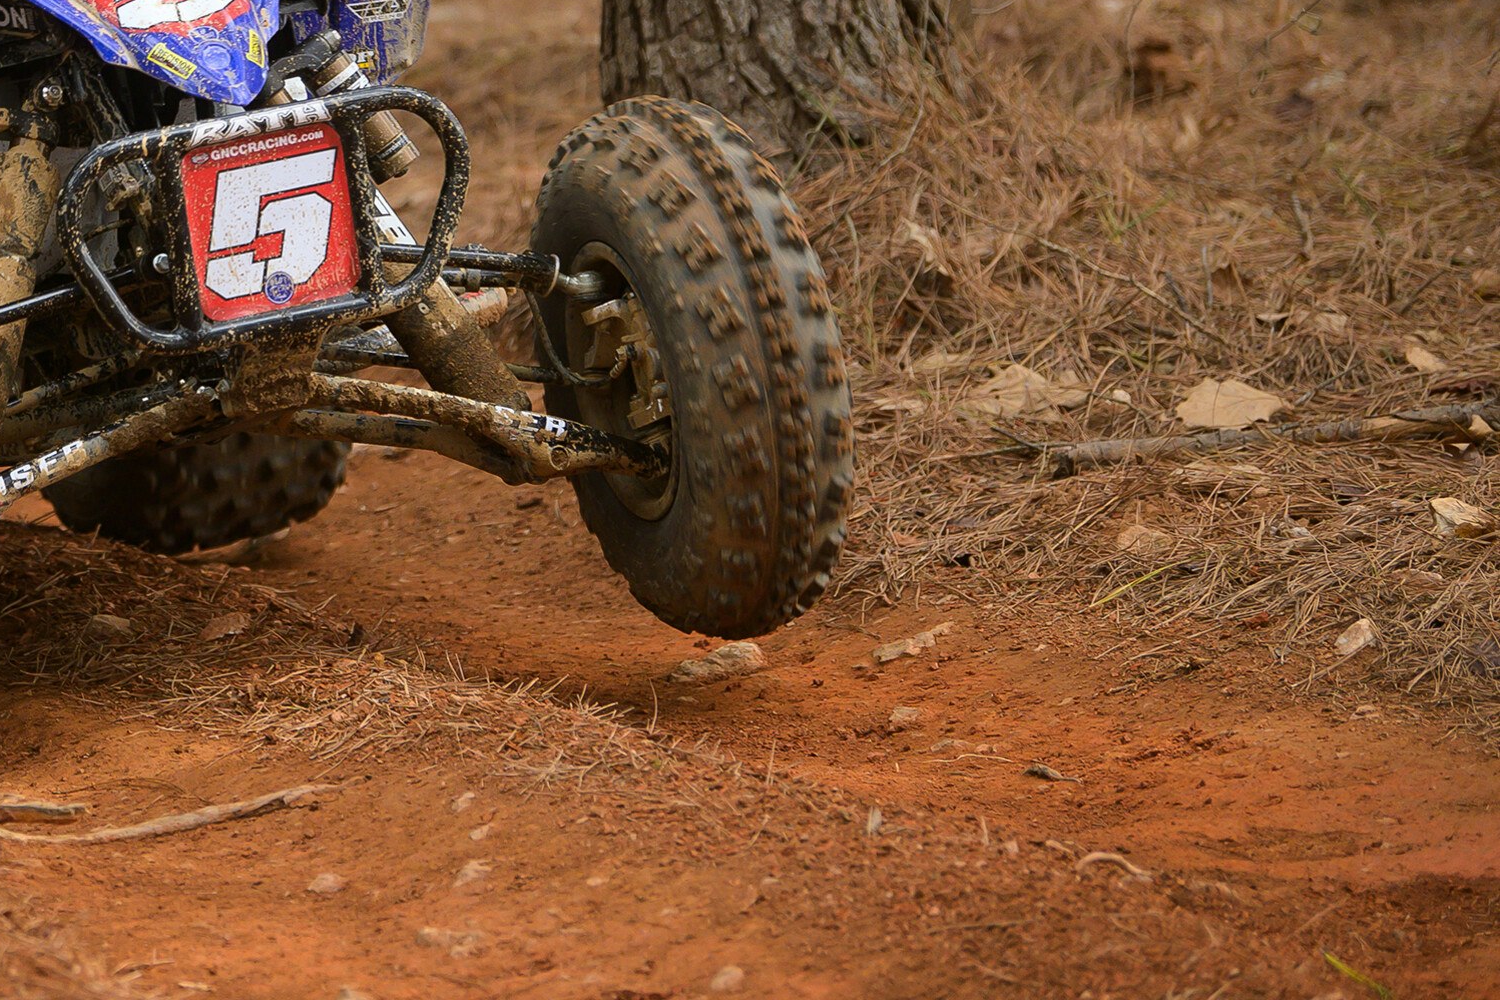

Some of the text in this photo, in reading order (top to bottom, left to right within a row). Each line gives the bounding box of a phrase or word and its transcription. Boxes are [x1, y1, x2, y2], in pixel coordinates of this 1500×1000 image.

[187, 99, 332, 147] RATH
[210, 130, 325, 161] GNCCRACING.COM
[205, 149, 317, 300] 5
